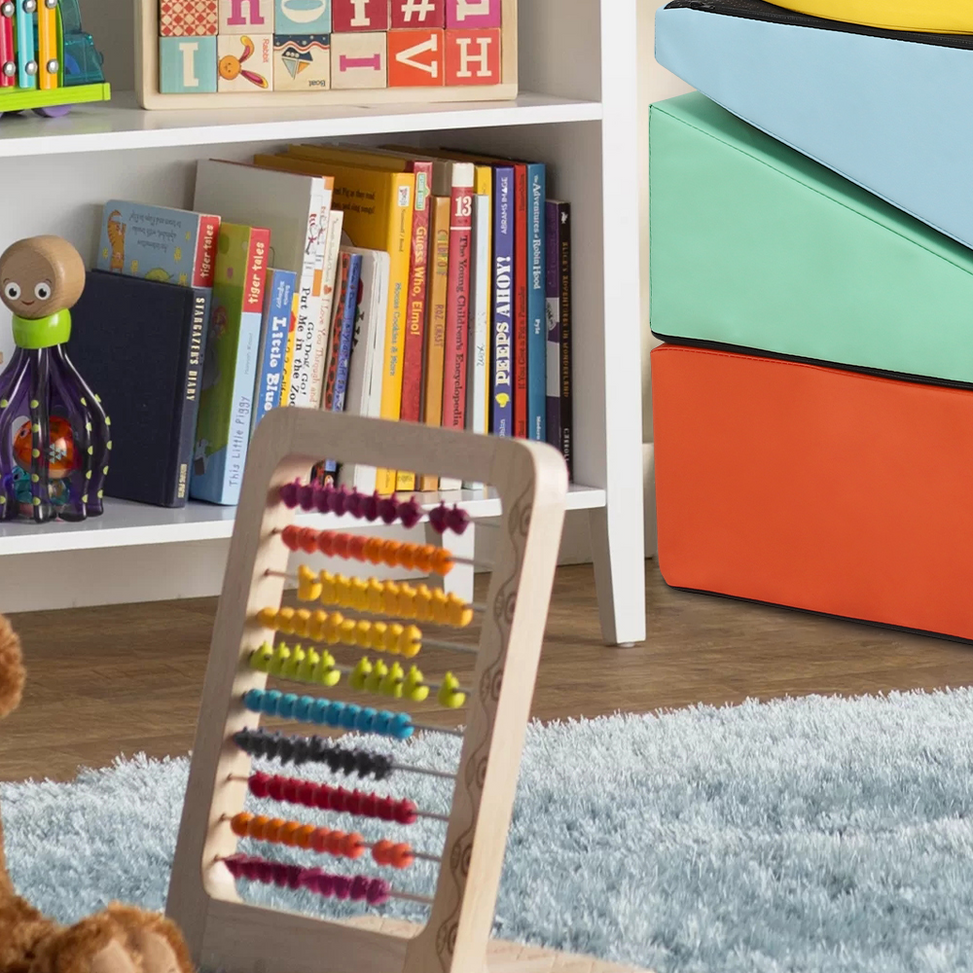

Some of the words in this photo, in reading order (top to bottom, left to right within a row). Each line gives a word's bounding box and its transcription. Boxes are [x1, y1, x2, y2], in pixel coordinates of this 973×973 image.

[455, 37, 493, 77] H
[455, 195, 473, 217] 13
[532, 182, 542, 232] Adventures
[202, 224, 214, 251] tales
[415, 226, 427, 263] Guess
[458, 235, 469, 257] The
[532, 239, 542, 266] Robin
[199, 252, 212, 278] tiger
[252, 241, 265, 271] tales
[247, 274, 262, 304] tiger
[411, 266, 424, 297] Who,
[455, 258, 467, 293] Young
[496, 256, 511, 318] AHOY!
[532, 266, 543, 289] Hood
[300, 287, 311, 309] Put
[297, 314, 308, 332] Me
[319, 305, 330, 325] Love
[410, 301, 423, 336] Elmo!
[454, 294, 466, 352] Children's
[533, 318, 541, 335] Pyle
[190, 297, 206, 365] STARGAZER'S
[269, 315, 287, 368] Little
[295, 338, 305, 352] in
[316, 328, 327, 345] You
[292, 358, 302, 379] the
[311, 347, 324, 384] Through
[496, 321, 511, 387] PEEPS
[186, 371, 199, 403] DIARY
[263, 372, 280, 412] Blue
[300, 372, 310, 396] Go!
[452, 353, 464, 427] Encyclopedia
[234, 395, 251, 425] Piggy
[231, 429, 245, 459] Little
[228, 463, 241, 487] This
